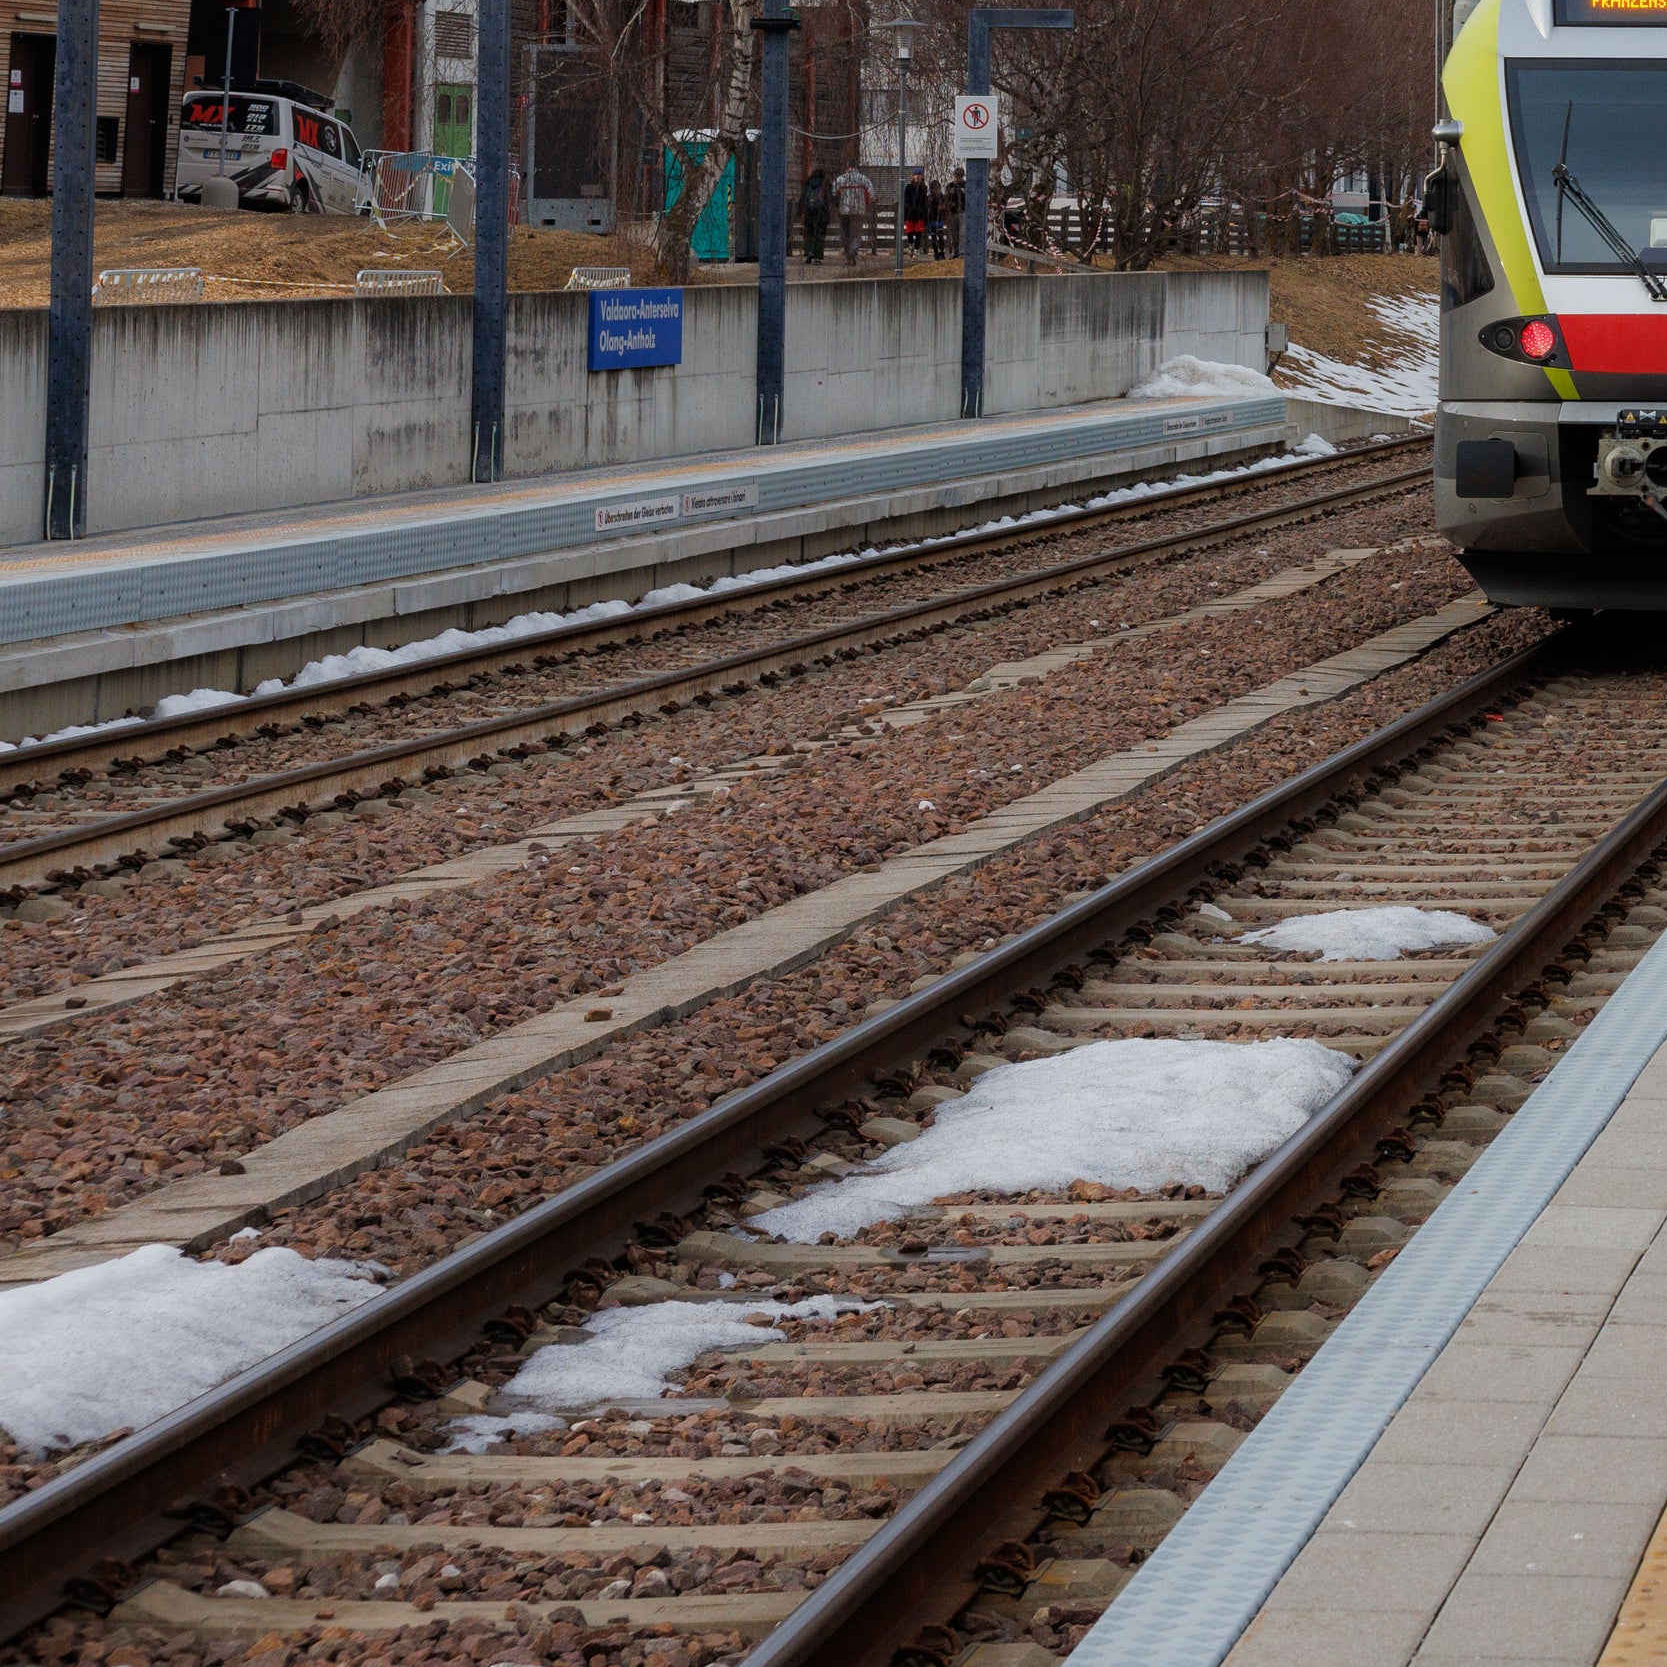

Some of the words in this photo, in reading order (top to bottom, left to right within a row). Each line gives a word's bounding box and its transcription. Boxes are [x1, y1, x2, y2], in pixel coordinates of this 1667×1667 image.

[190, 104, 235, 123] MX
[297, 115, 319, 150] MX
[600, 297, 679, 321] Valdaora-Anterselva
[600, 327, 656, 356] Olang-Antholz
[633, 511, 642, 520] der
[641, 506, 655, 520] Gleise
[691, 496, 706, 509] Vietato
